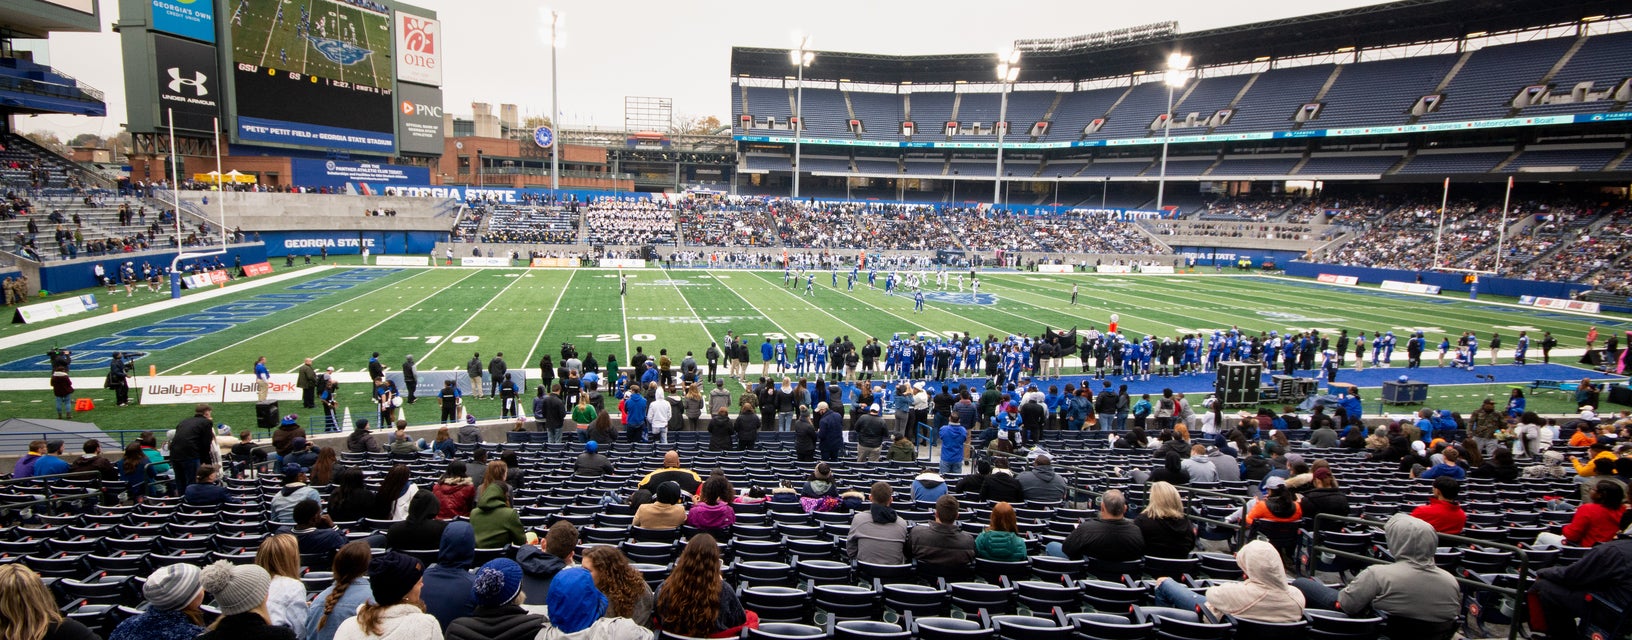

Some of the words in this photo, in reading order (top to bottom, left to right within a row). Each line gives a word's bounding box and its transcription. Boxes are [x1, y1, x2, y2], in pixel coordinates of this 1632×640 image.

[153, 1, 193, 15] GEORGIA'S
[195, 11, 211, 20] OWN
[166, 10, 184, 18] CREDIT
[404, 53, 435, 69] one
[238, 63, 258, 73] GSU
[289, 72, 301, 80] GS
[162, 94, 186, 102] UNDER
[187, 98, 216, 106] ARMOUR
[415, 103, 442, 118] PNC
[242, 125, 269, 134] "PETE"
[270, 128, 291, 136] PETIT
[292, 130, 311, 138] FIELD
[319, 133, 347, 142] GEORGIA
[348, 136, 366, 144] STATE
[366, 138, 393, 146] STADIUM
[465, 189, 516, 203] STATE
[284, 238, 335, 248] GEORGIA
[338, 238, 375, 247] STATE
[1207, 252, 1236, 260] STATE
[425, 335, 480, 344] 10
[596, 333, 656, 342] 20
[763, 332, 821, 340] 30
[148, 383, 215, 396] WallyPark
[231, 382, 296, 393] WallPark
